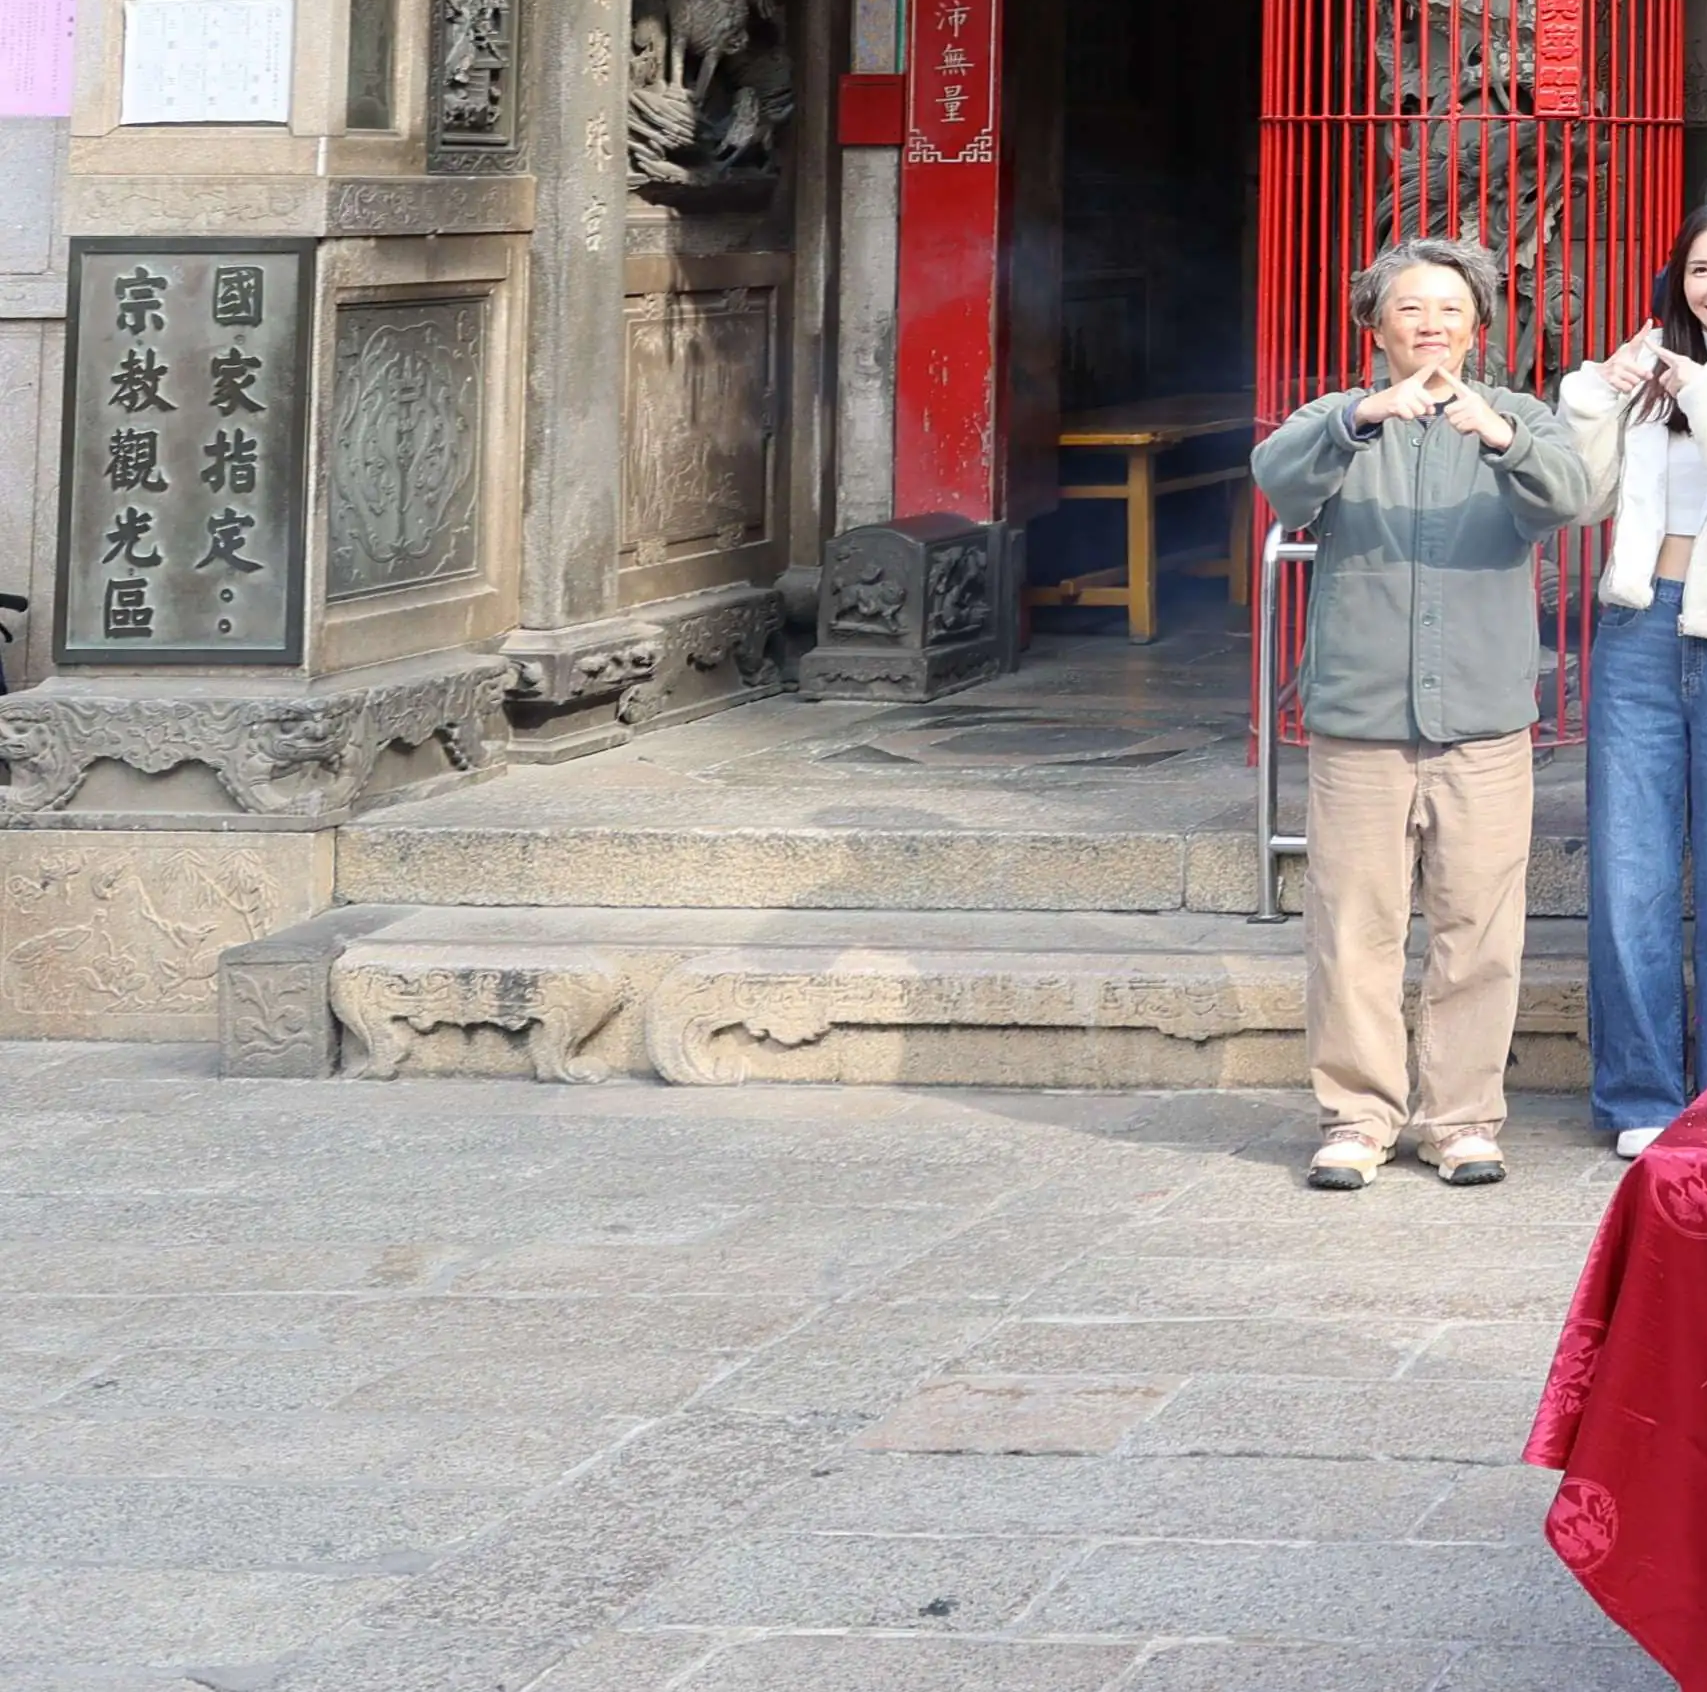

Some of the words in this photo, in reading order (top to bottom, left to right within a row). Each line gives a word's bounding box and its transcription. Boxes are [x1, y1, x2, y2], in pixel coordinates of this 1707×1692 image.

[102, 266, 178, 639] 宗教觀光區
